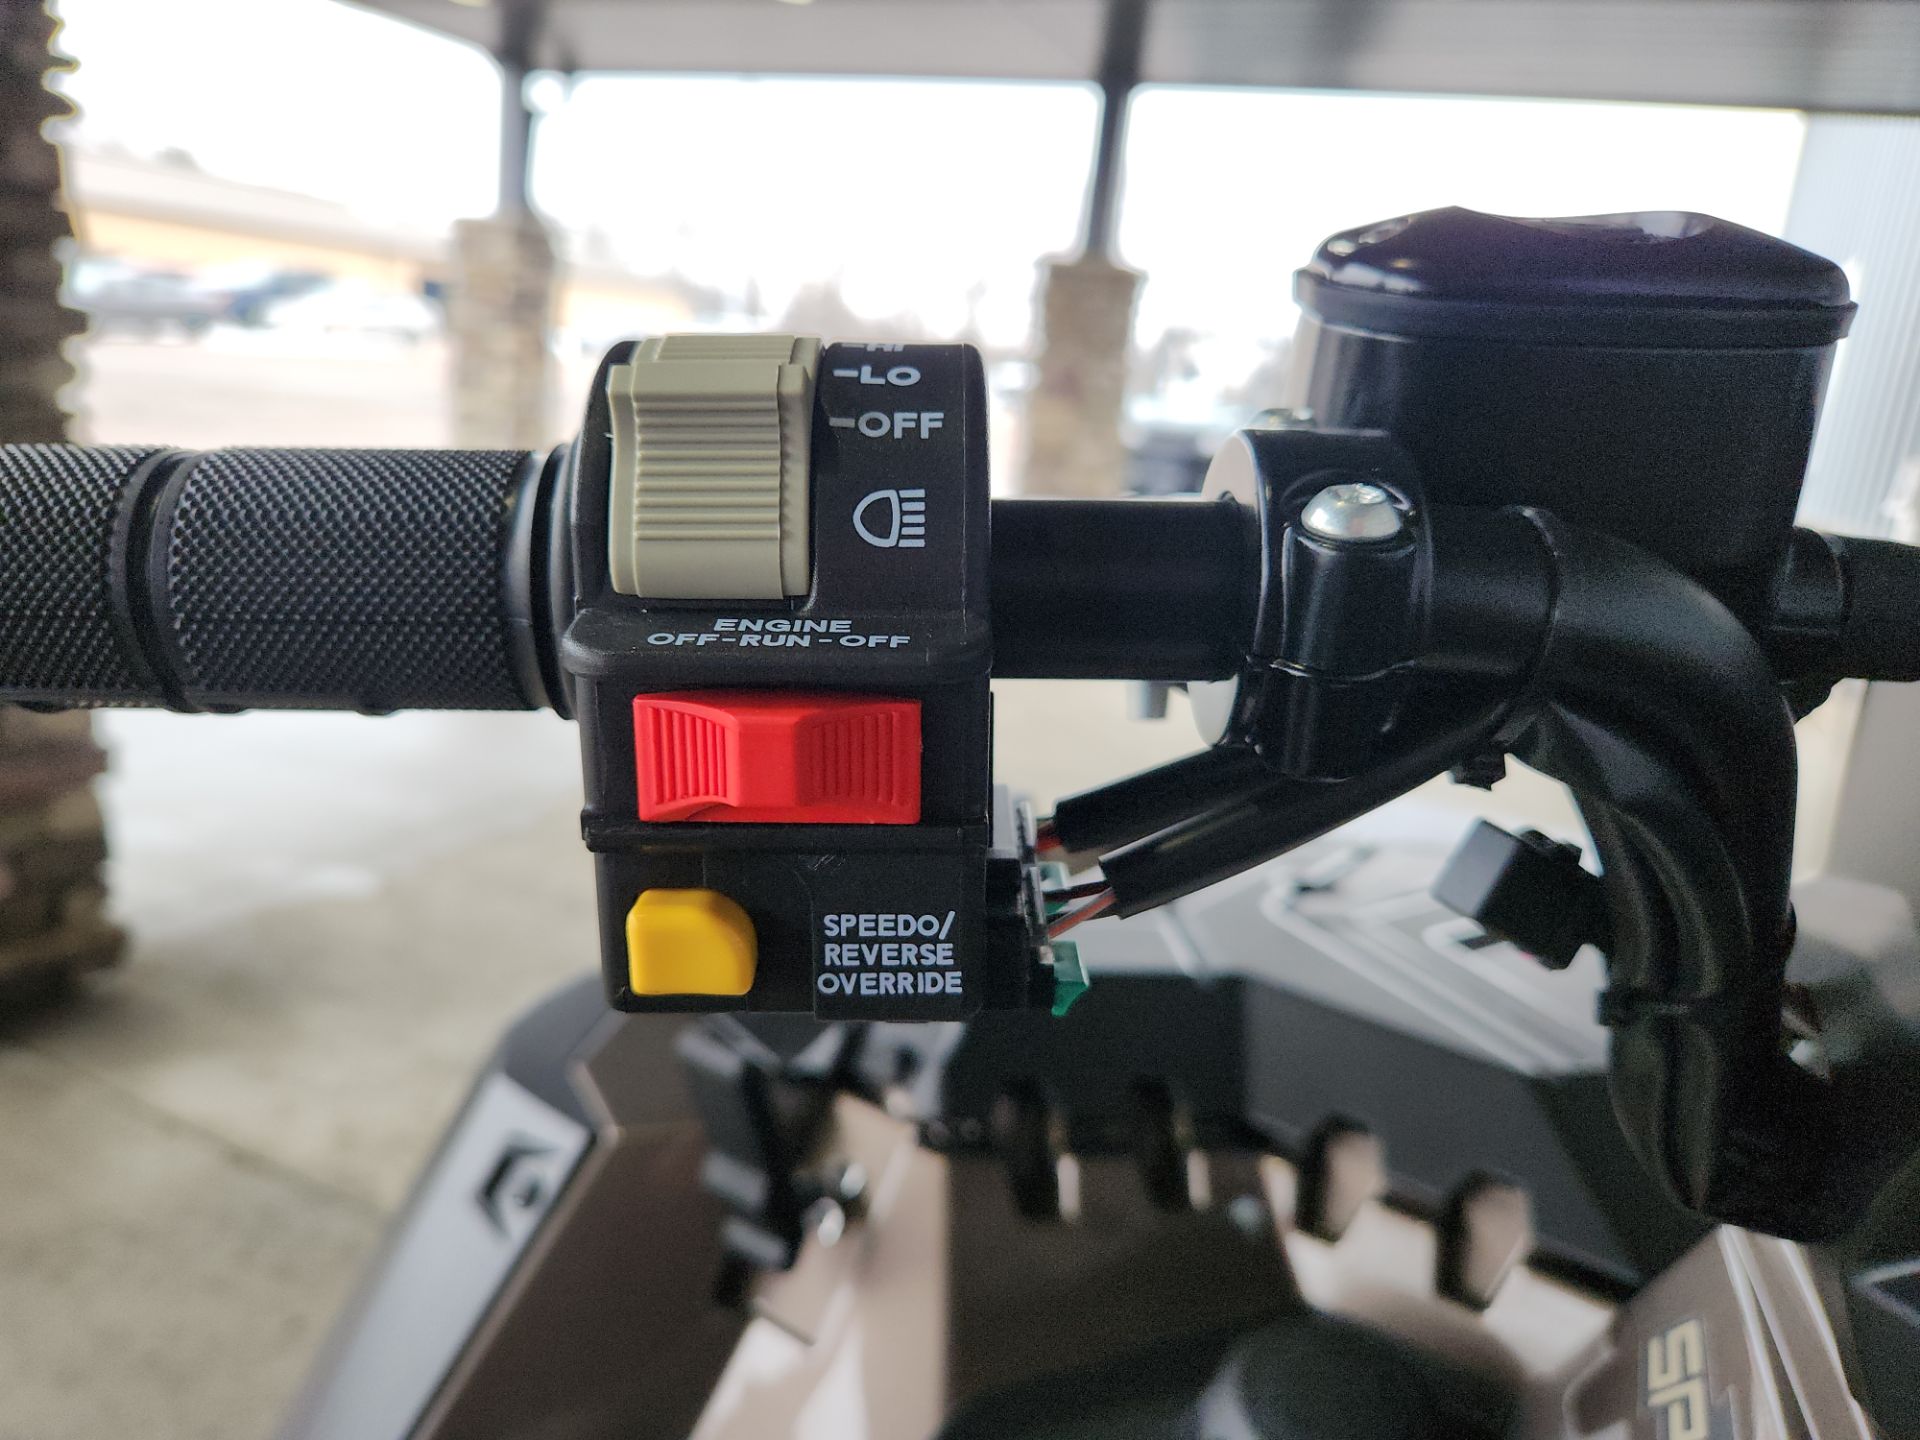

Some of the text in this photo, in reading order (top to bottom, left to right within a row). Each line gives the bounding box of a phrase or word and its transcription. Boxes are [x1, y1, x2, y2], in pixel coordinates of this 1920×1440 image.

[860, 365, 921, 387] LO
[858, 411, 944, 440] OFF
[713, 618, 852, 633] ENGINE
[823, 911, 956, 940] SPEEDO/
[824, 943, 954, 966] REVERSE
[817, 971, 963, 995] OVERRIDE
